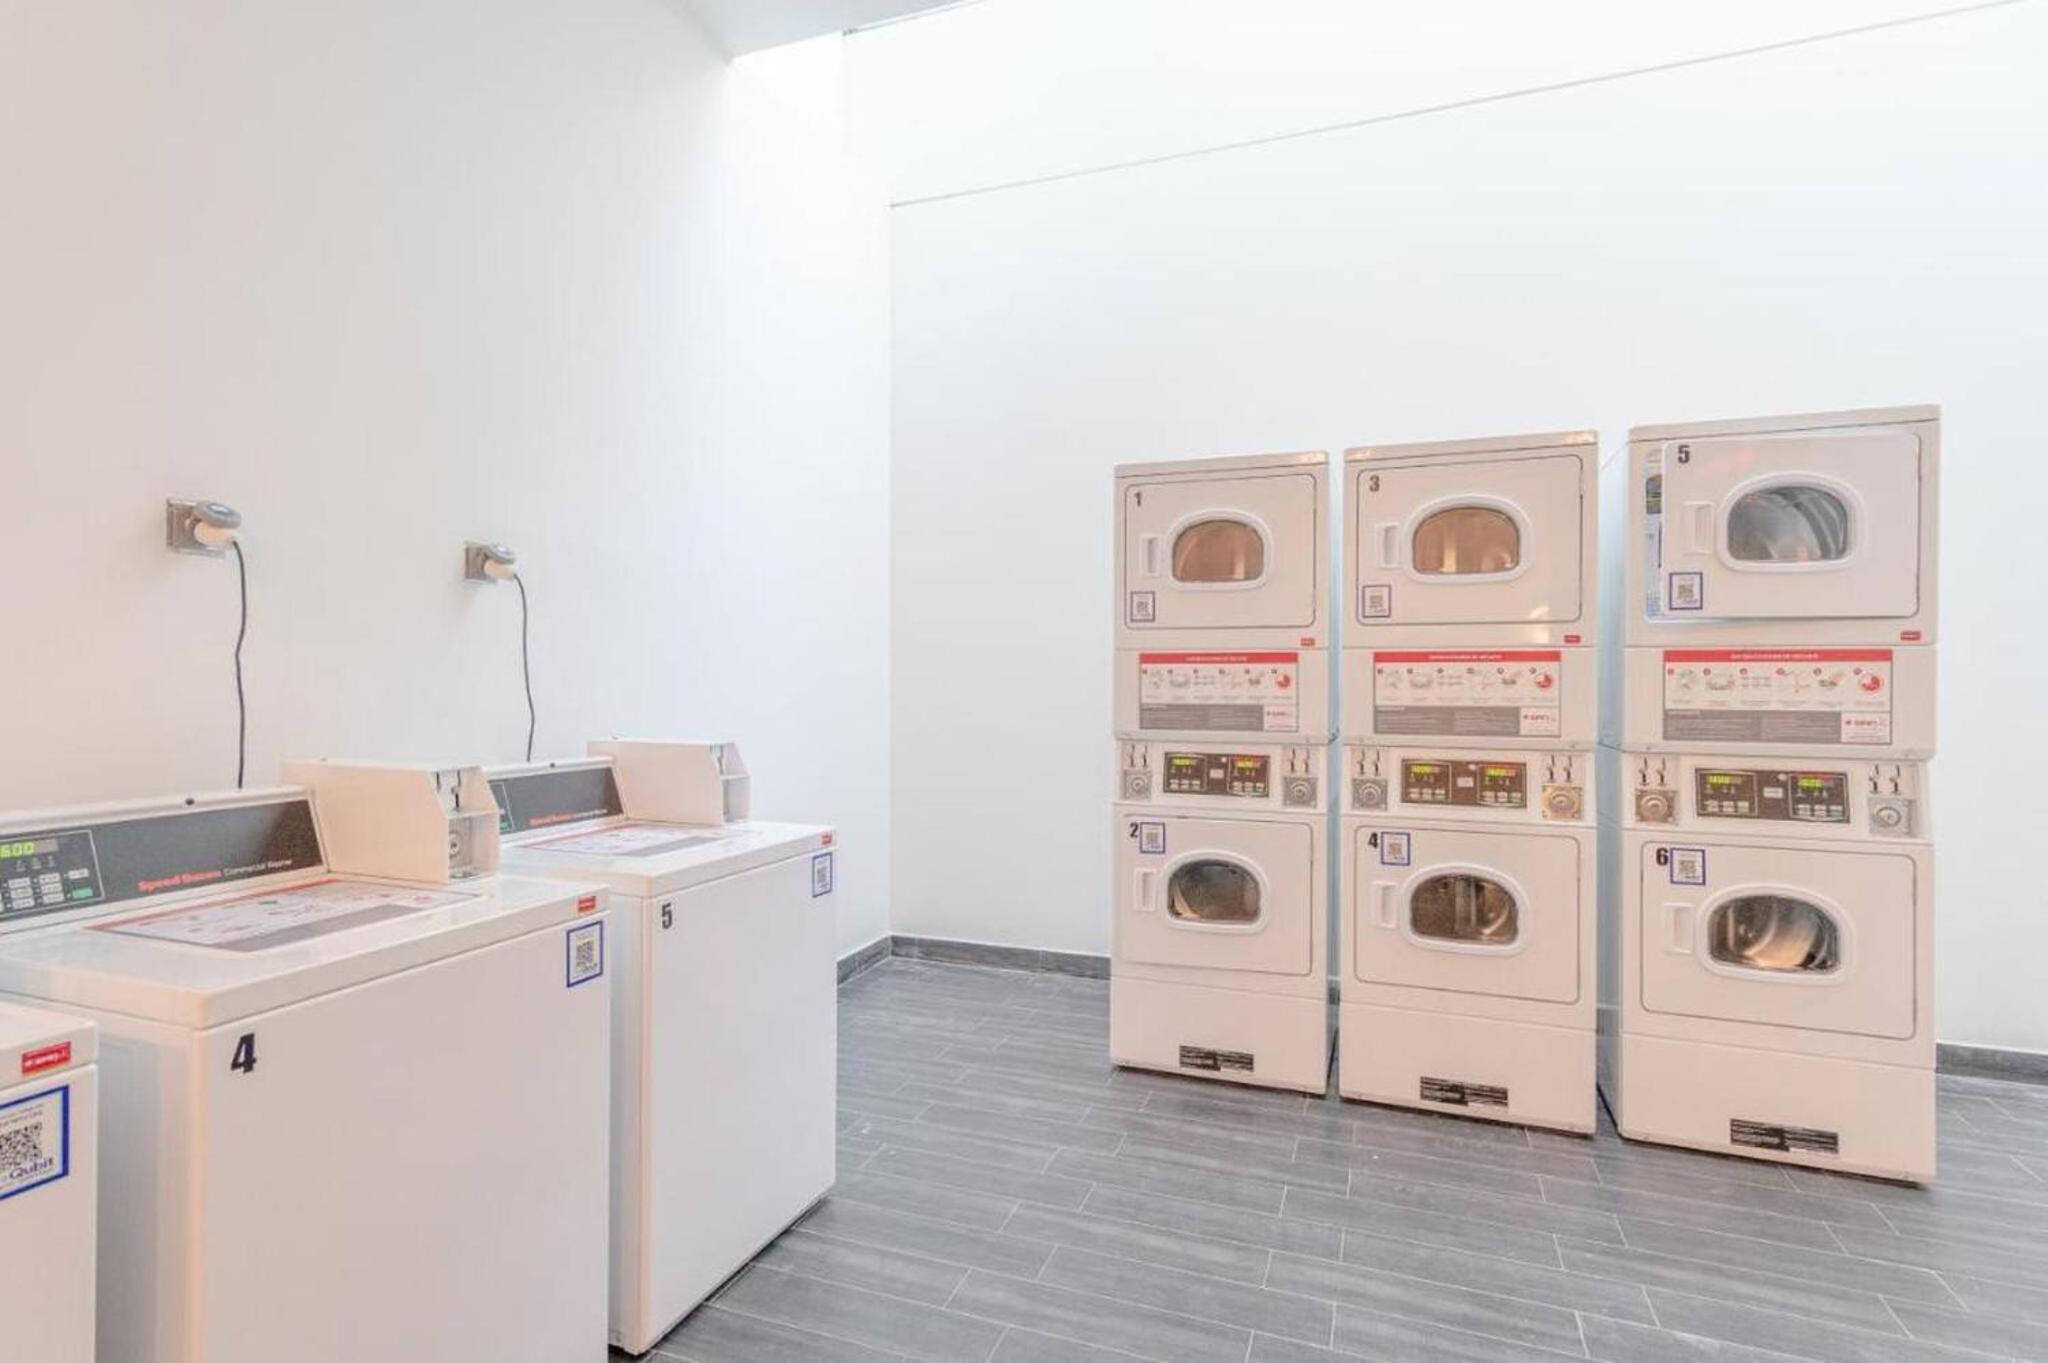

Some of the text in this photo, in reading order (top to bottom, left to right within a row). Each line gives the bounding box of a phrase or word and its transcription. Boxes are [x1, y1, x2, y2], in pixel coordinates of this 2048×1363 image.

[1677, 444, 1691, 464] 5
[1369, 474, 1380, 492] 3
[1133, 491, 1141, 507] 1
[1129, 822, 1139, 838] 2
[1367, 832, 1378, 849] 4
[1655, 847, 1669, 866] 6
[661, 902, 673, 930] 5
[230, 1033, 257, 1074] 4
